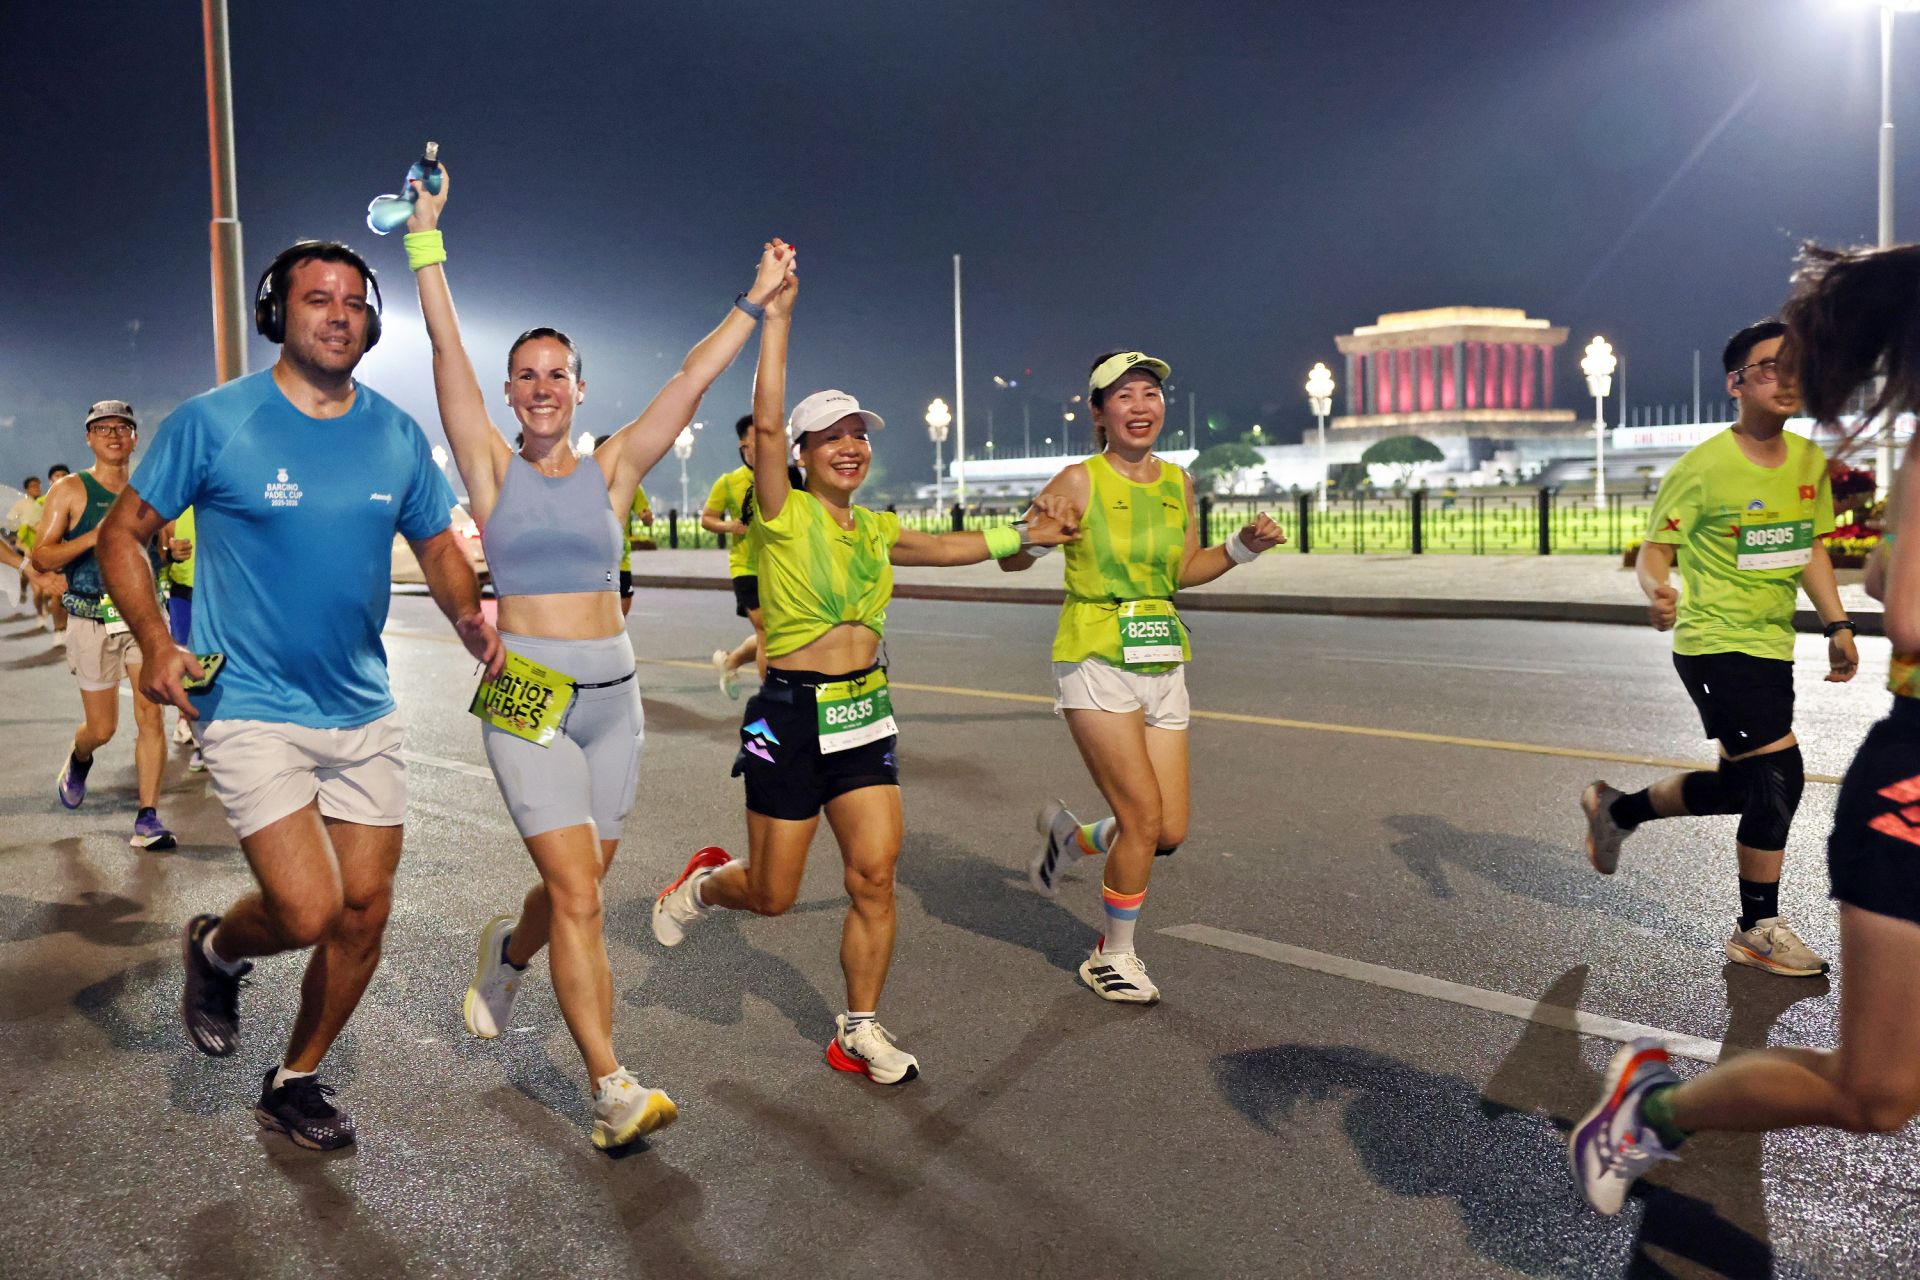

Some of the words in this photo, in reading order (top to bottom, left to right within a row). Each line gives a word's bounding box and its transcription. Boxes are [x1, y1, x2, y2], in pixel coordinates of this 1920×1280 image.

[264, 491, 288, 499] PADEL
[289, 491, 303, 499] CUP
[266, 483, 299, 491] BARCINO
[1745, 527, 1794, 547] 80505
[1128, 621, 1170, 638] 82555
[825, 697, 873, 725] 82635
